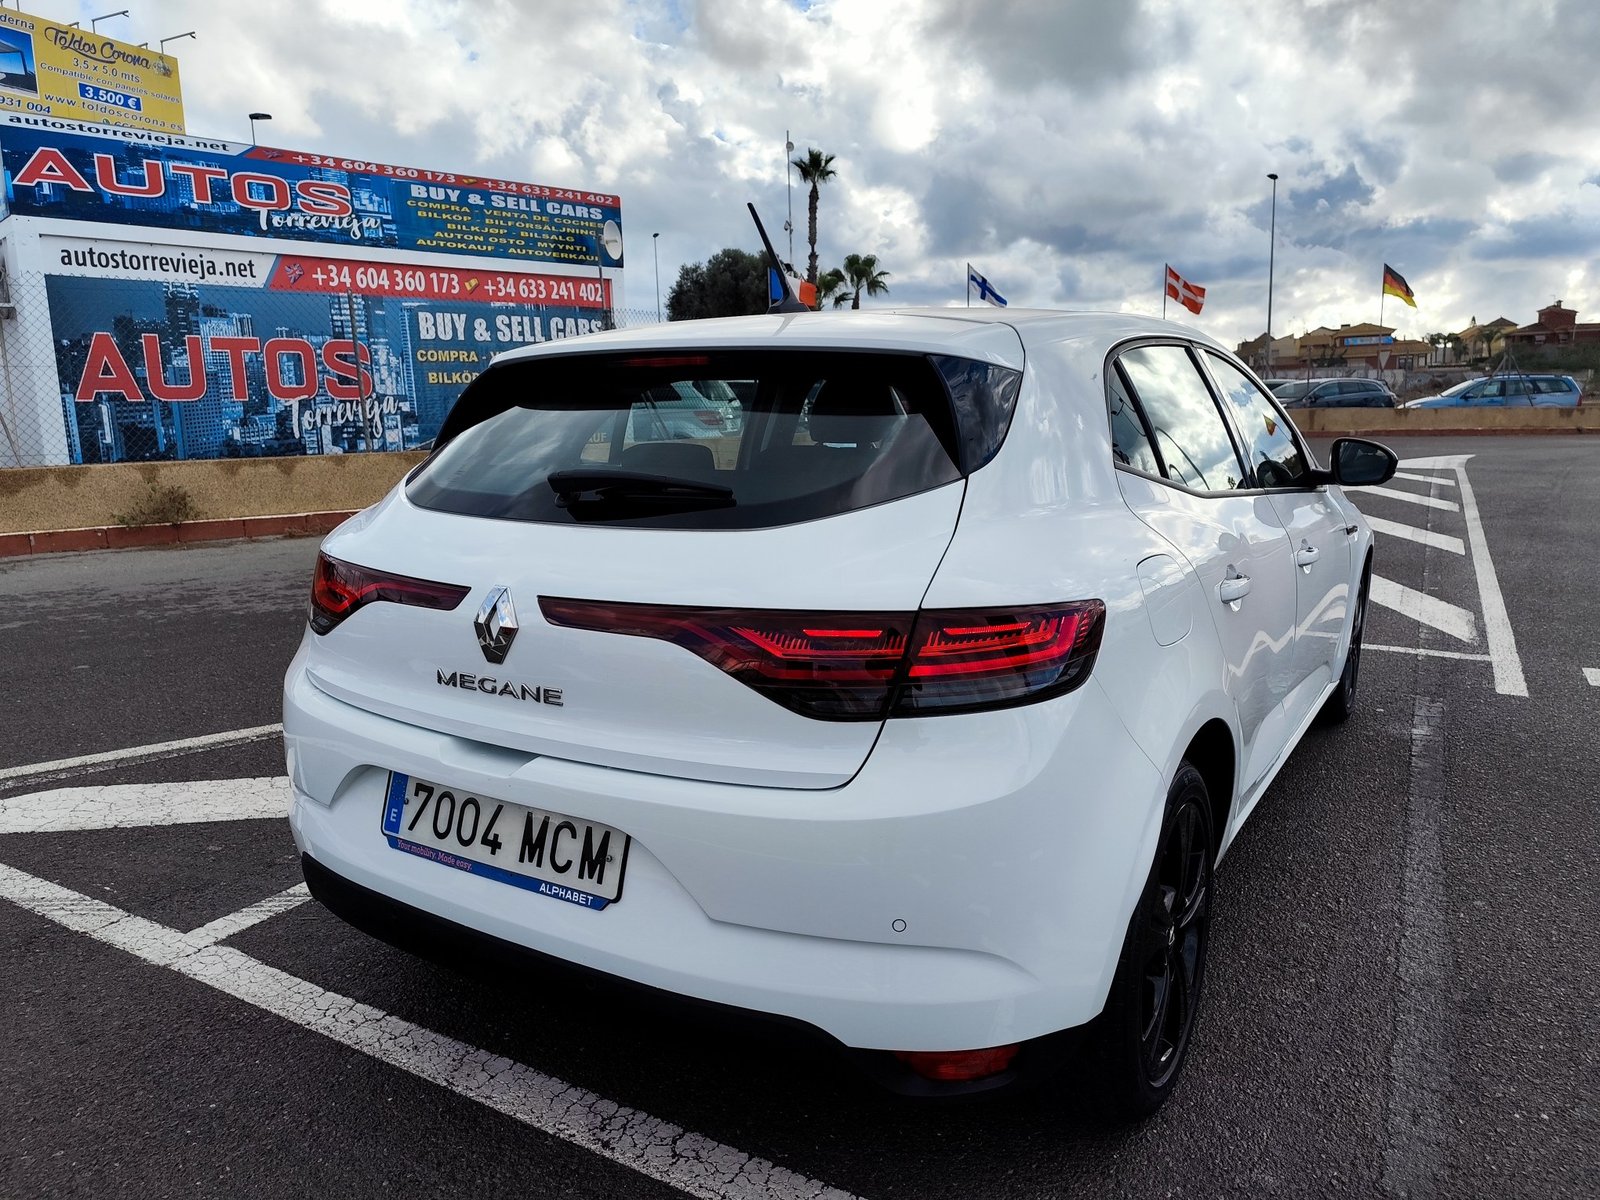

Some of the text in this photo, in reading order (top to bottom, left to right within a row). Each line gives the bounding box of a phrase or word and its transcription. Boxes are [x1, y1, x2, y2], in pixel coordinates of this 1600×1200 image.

[44, 26, 151, 70] Toldos Corona
[40, 62, 180, 103] Compatible con paneles solares
[73, 57, 143, 84] 3,5 x 5,0 mts.
[26, 101, 51, 114] 004
[84, 86, 138, 109] 3.500 €
[44, 93, 183, 132] www.toldoscorona.es
[8, 115, 230, 152] autostorrevieja.net
[12, 146, 352, 217] AUTOS
[292, 155, 456, 183] +34 604 360 173
[410, 184, 603, 220] BUY & SELL CARS
[483, 180, 613, 205] +34 633 241 402
[251, 207, 381, 240] Torrevieja
[406, 200, 471, 213] COMPRA
[483, 208, 529, 220] VENTA
[532, 214, 549, 222] DE
[554, 217, 604, 228] COCHES
[416, 239, 495, 252] AUTOKAUF
[434, 231, 484, 242] AUTON
[488, 236, 526, 246] OSTO
[537, 241, 587, 252] MYYNTI
[520, 231, 575, 242] BILSALG
[60, 247, 257, 280] autostorrevieja.net
[311, 265, 460, 294] +34 604 360 173
[484, 276, 603, 302] +34 633 241 402
[418, 311, 467, 341] BUY
[473, 317, 491, 342] &
[495, 314, 546, 343] SELL
[75, 331, 373, 402] AUTOS
[416, 349, 479, 362] COMPRA
[284, 393, 399, 439] Torrevieja
[436, 667, 564, 707] MEGANE
[390, 808, 398, 823] E
[407, 782, 611, 885] 7004 MCM
[397, 838, 411, 851] Your
[437, 852, 455, 865] Made
[539, 883, 594, 906] ALPHABET
